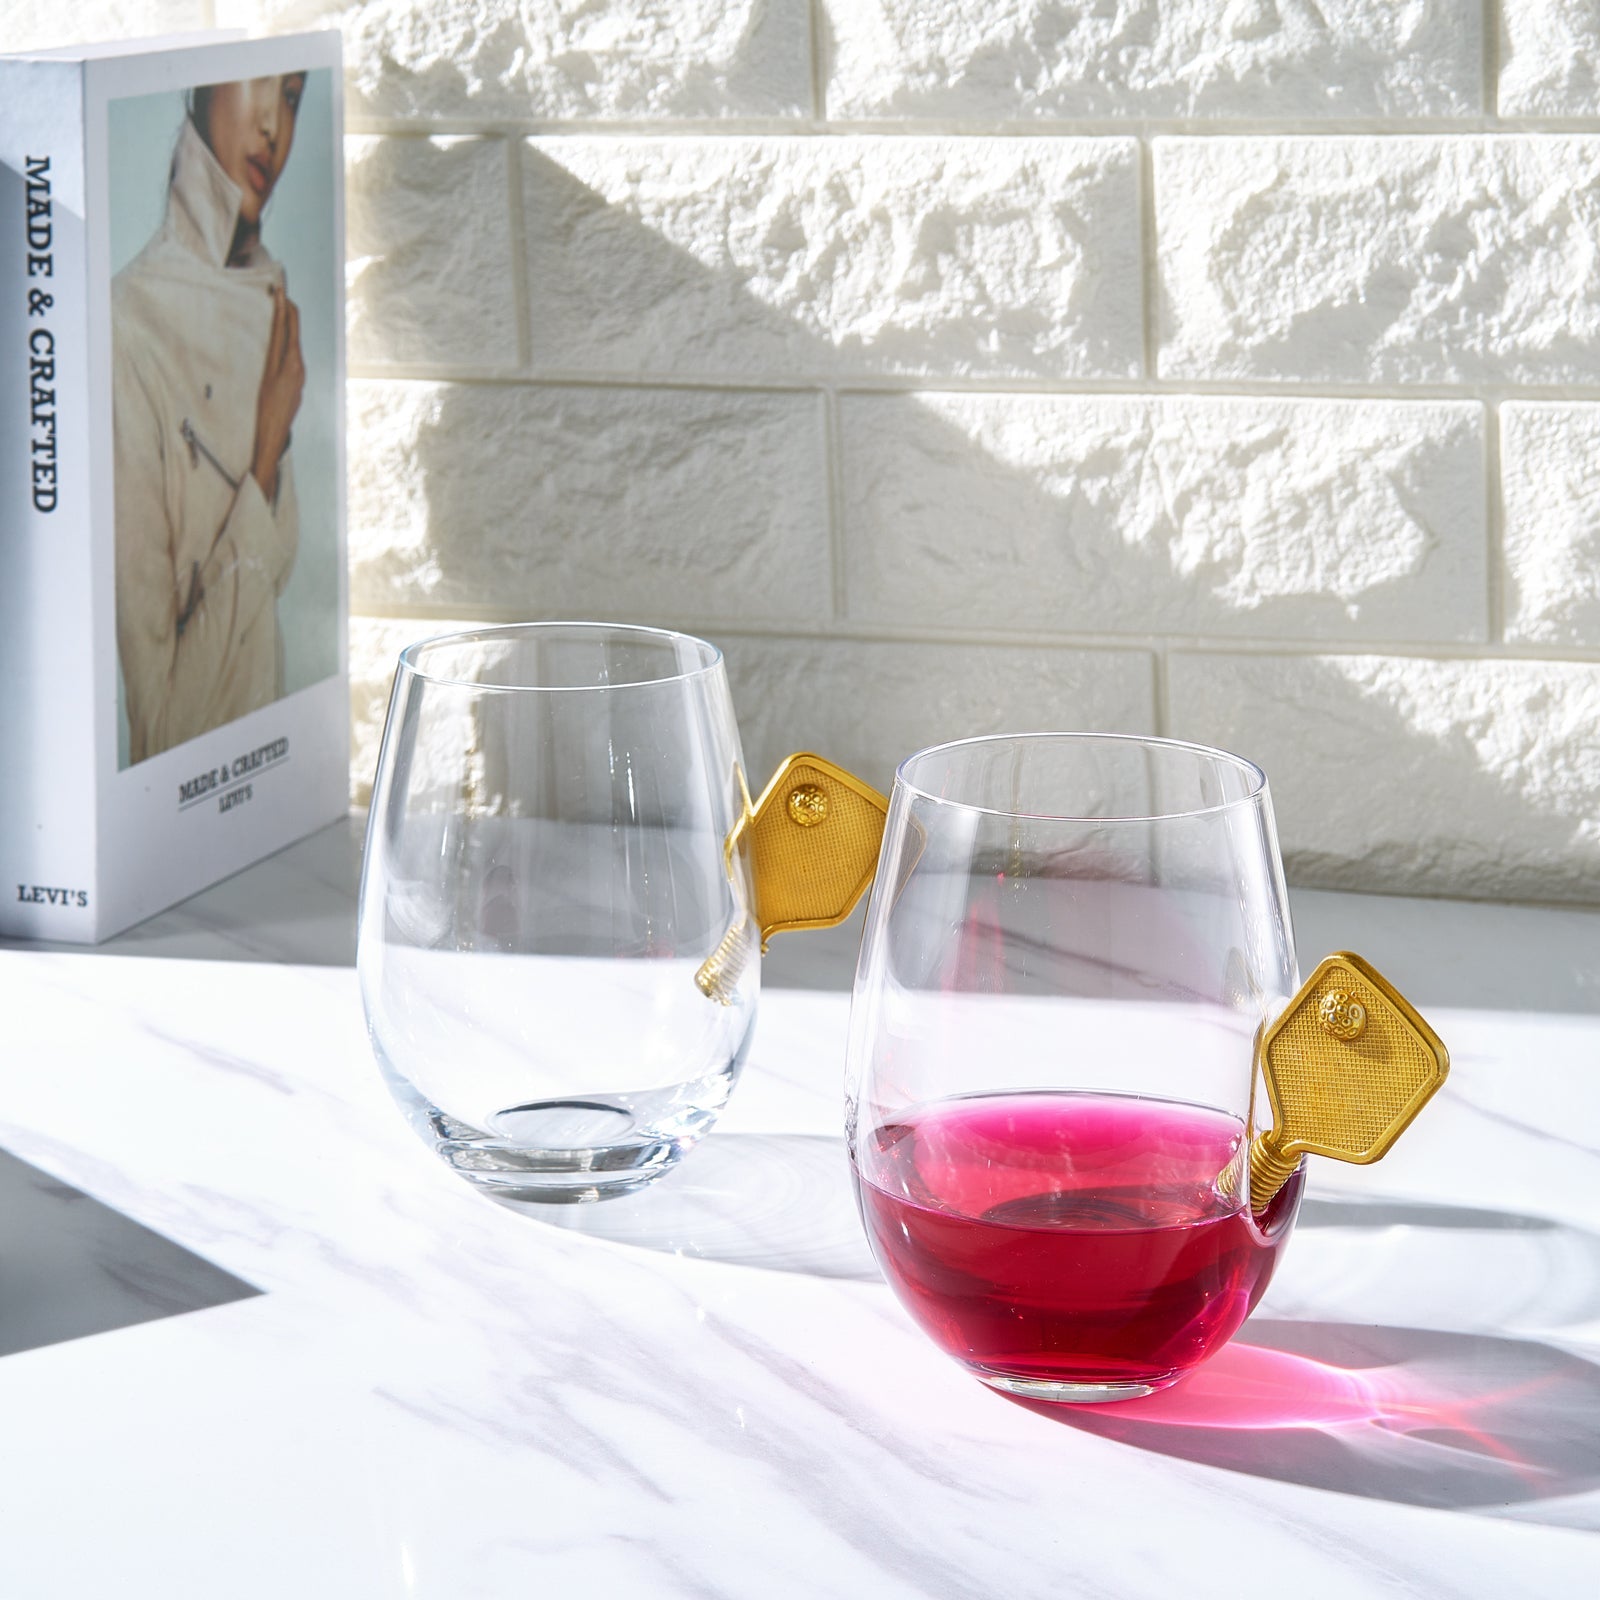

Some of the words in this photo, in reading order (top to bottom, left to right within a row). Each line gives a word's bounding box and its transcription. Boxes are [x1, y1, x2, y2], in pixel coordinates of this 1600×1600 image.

[24, 154, 53, 277] MADE
[27, 287, 54, 316] &
[29, 328, 59, 514] CRAFTED
[17, 883, 88, 907] LEVI'S
